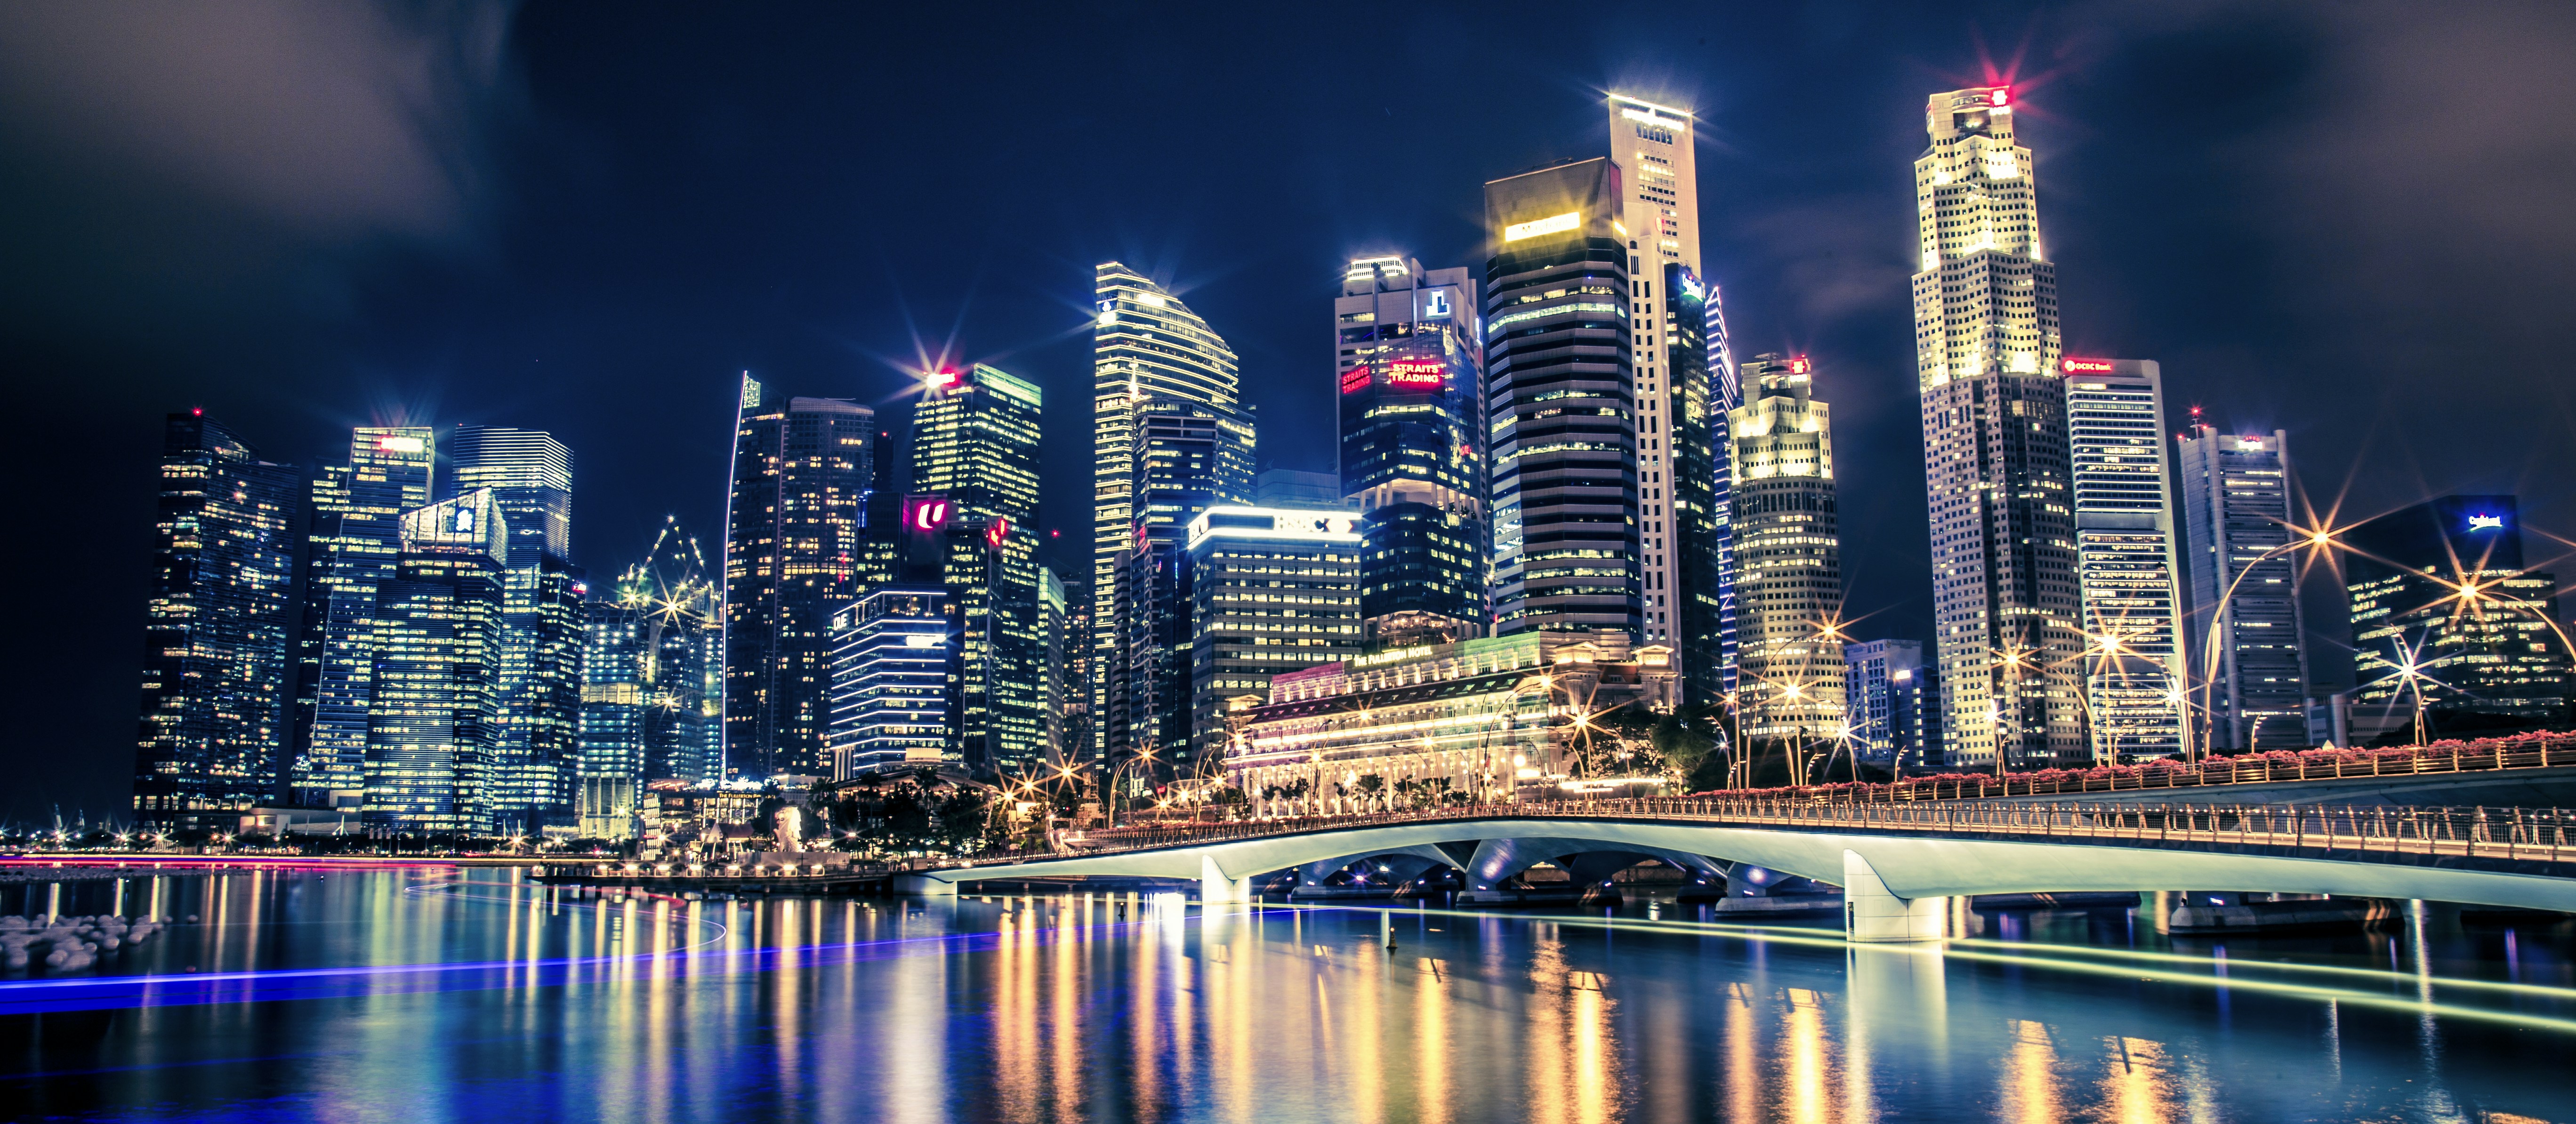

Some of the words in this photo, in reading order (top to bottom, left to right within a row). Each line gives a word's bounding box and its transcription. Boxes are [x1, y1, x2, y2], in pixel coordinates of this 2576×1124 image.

[1343, 366, 1368, 384] STRAITS
[1393, 364, 1438, 373] STRAITS
[1343, 376, 1370, 394] TRADING
[1391, 374, 1439, 383] TRADING
[1354, 654, 1367, 666] THE
[1368, 650, 1407, 665] FULLERTON
[1408, 646, 1433, 658] HOTEL
